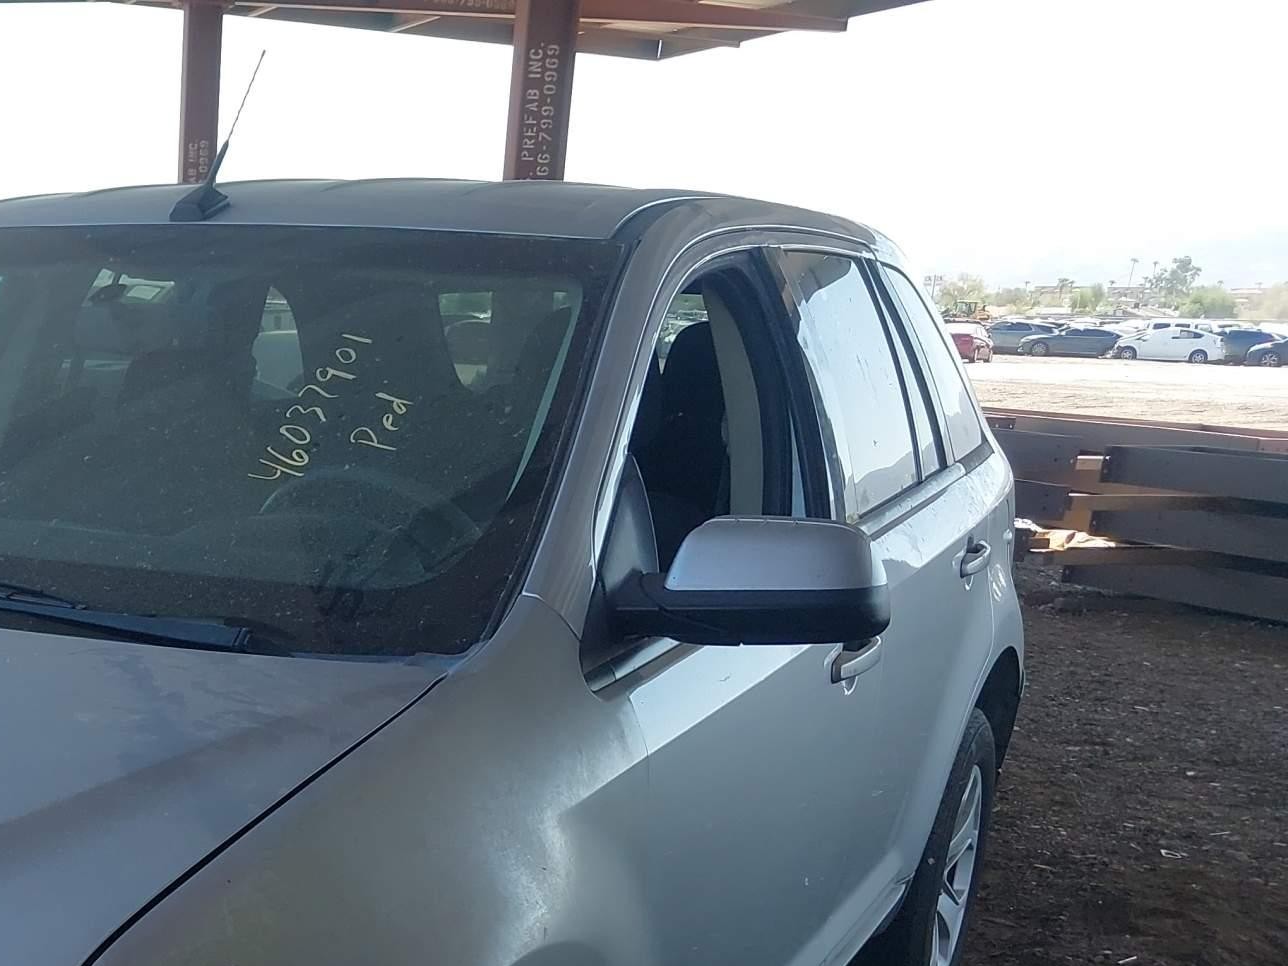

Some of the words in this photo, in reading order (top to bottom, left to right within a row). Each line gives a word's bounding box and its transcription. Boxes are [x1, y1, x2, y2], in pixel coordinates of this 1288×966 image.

[527, 42, 544, 79] INC.
[520, 88, 540, 161] PREFAB
[247, 333, 373, 480] 46037901
